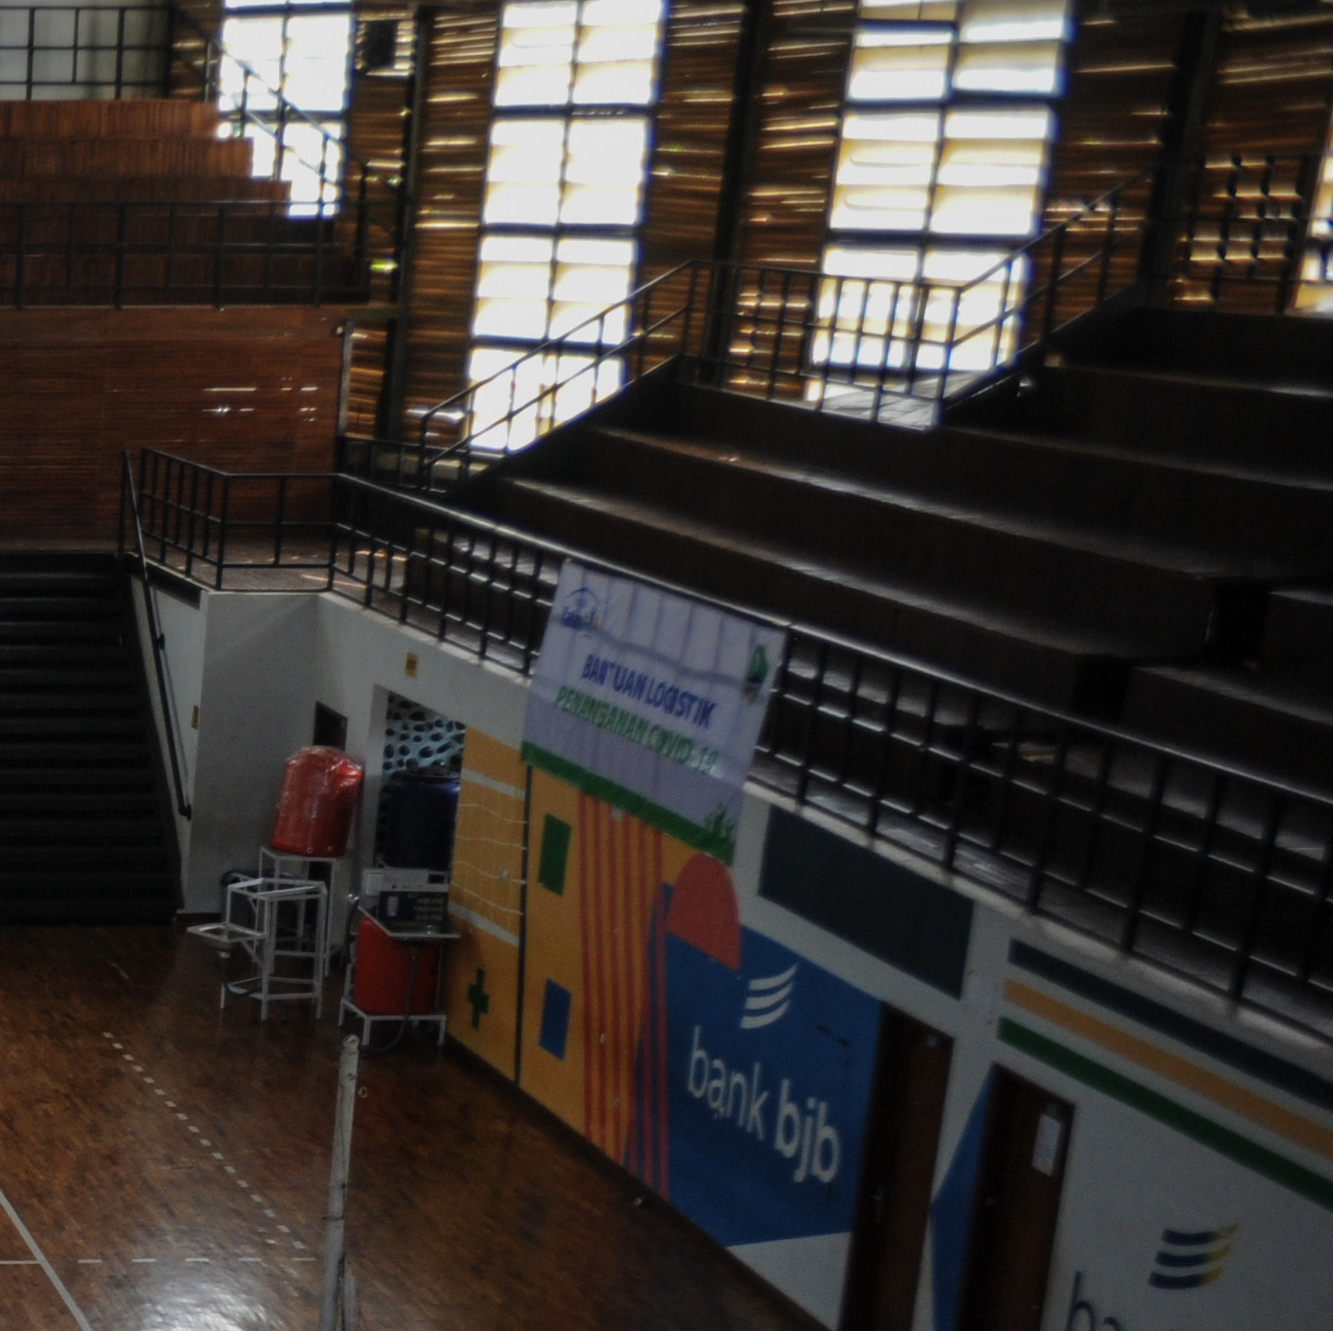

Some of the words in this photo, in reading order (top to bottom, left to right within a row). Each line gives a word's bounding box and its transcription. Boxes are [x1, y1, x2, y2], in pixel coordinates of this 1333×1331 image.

[644, 678, 717, 729] LOGISTIK
[687, 1024, 770, 1141] bank
[775, 1078, 841, 1184] bjb
